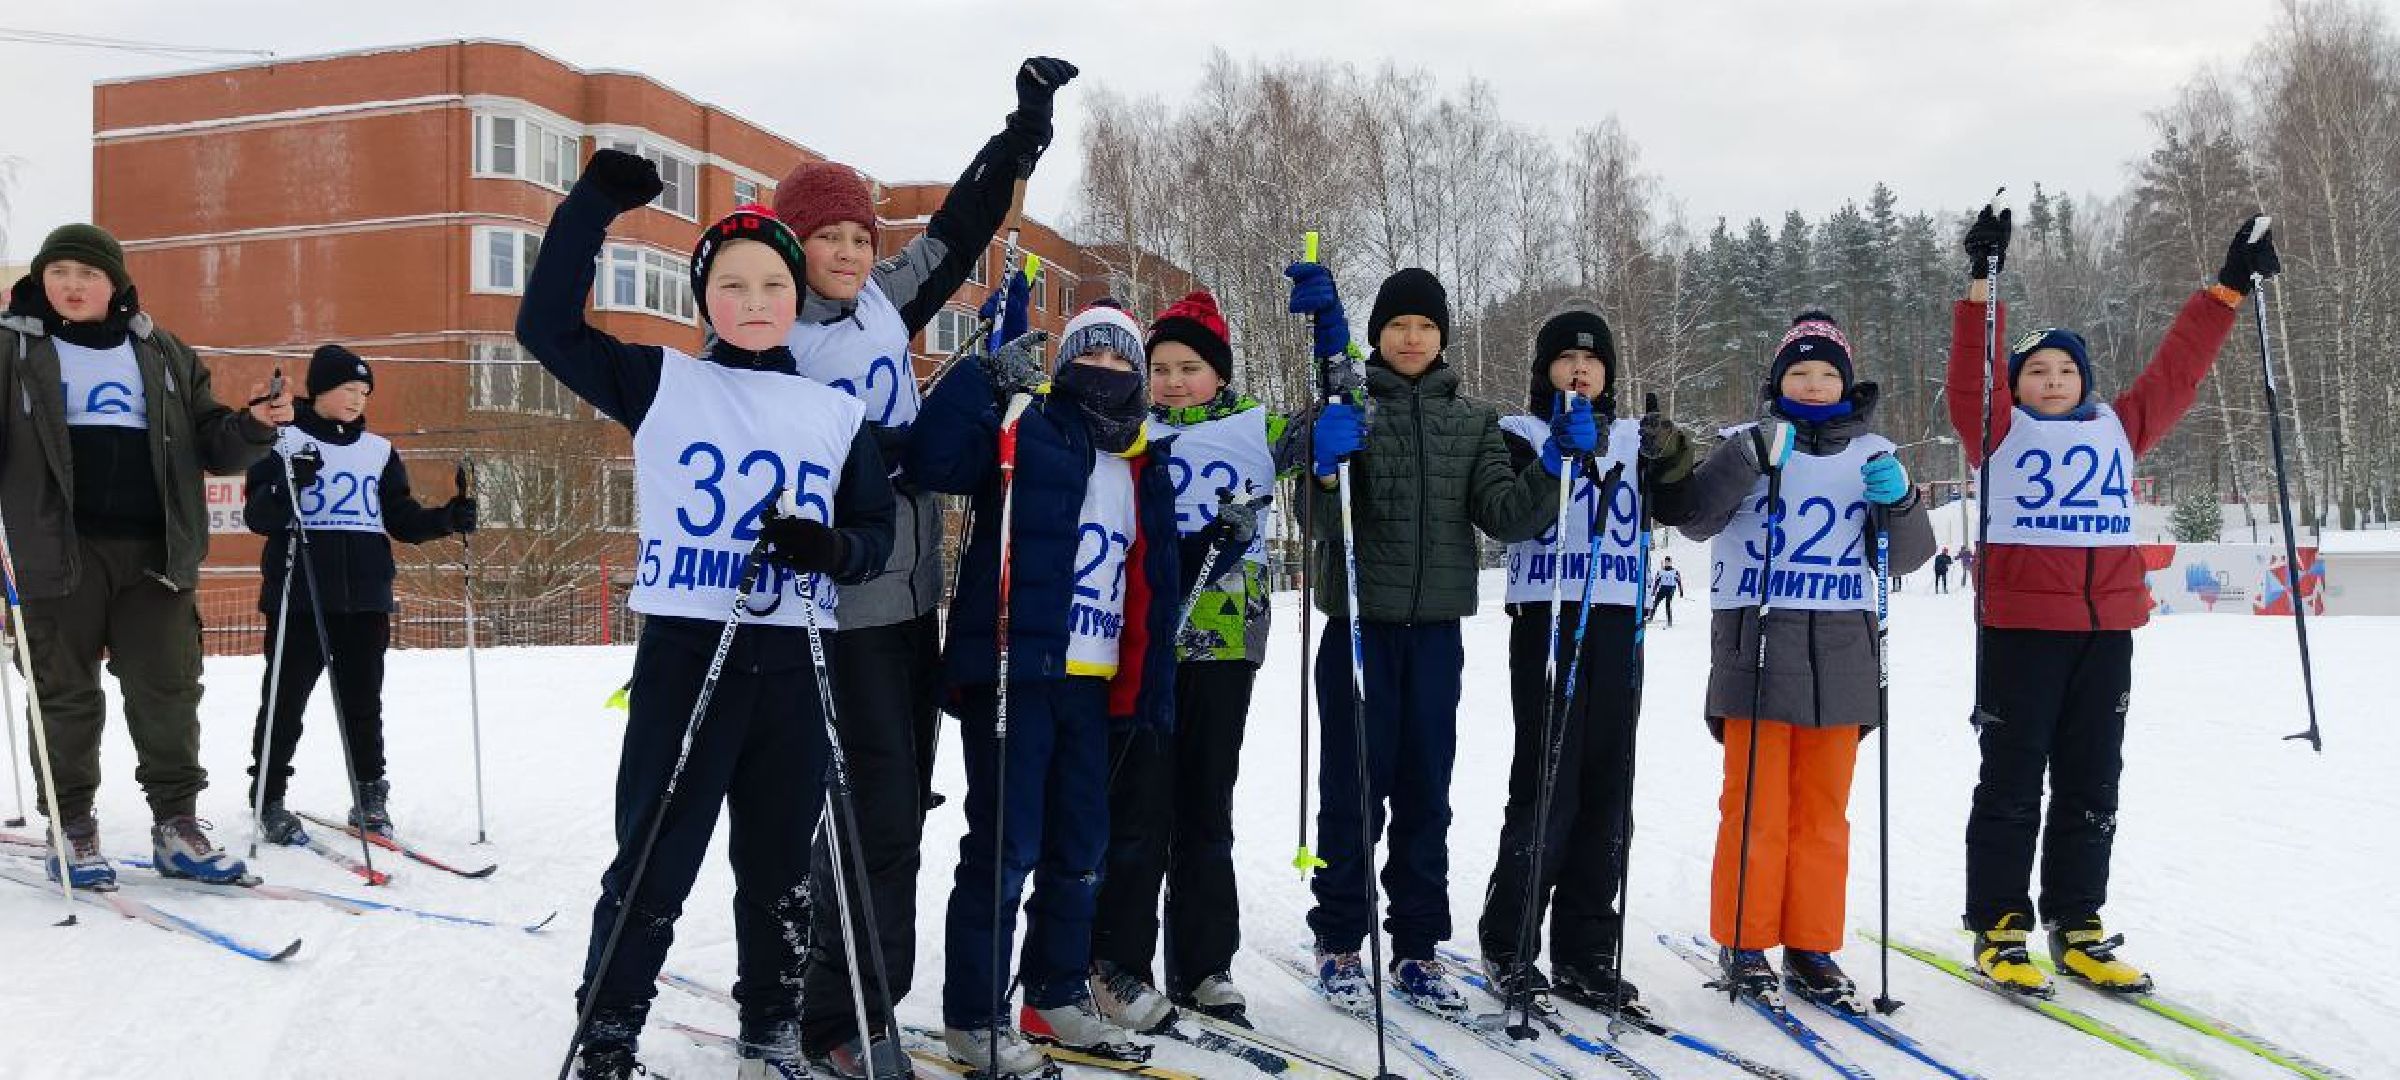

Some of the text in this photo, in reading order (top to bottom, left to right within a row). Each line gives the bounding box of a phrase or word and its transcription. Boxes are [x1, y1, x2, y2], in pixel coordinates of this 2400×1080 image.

[300, 471, 379, 518] 320
[676, 441, 831, 543] 325
[2014, 444, 2129, 509] 324
[1745, 495, 1867, 567] 322
[1736, 566, 1864, 601] ДМИТРОВ
